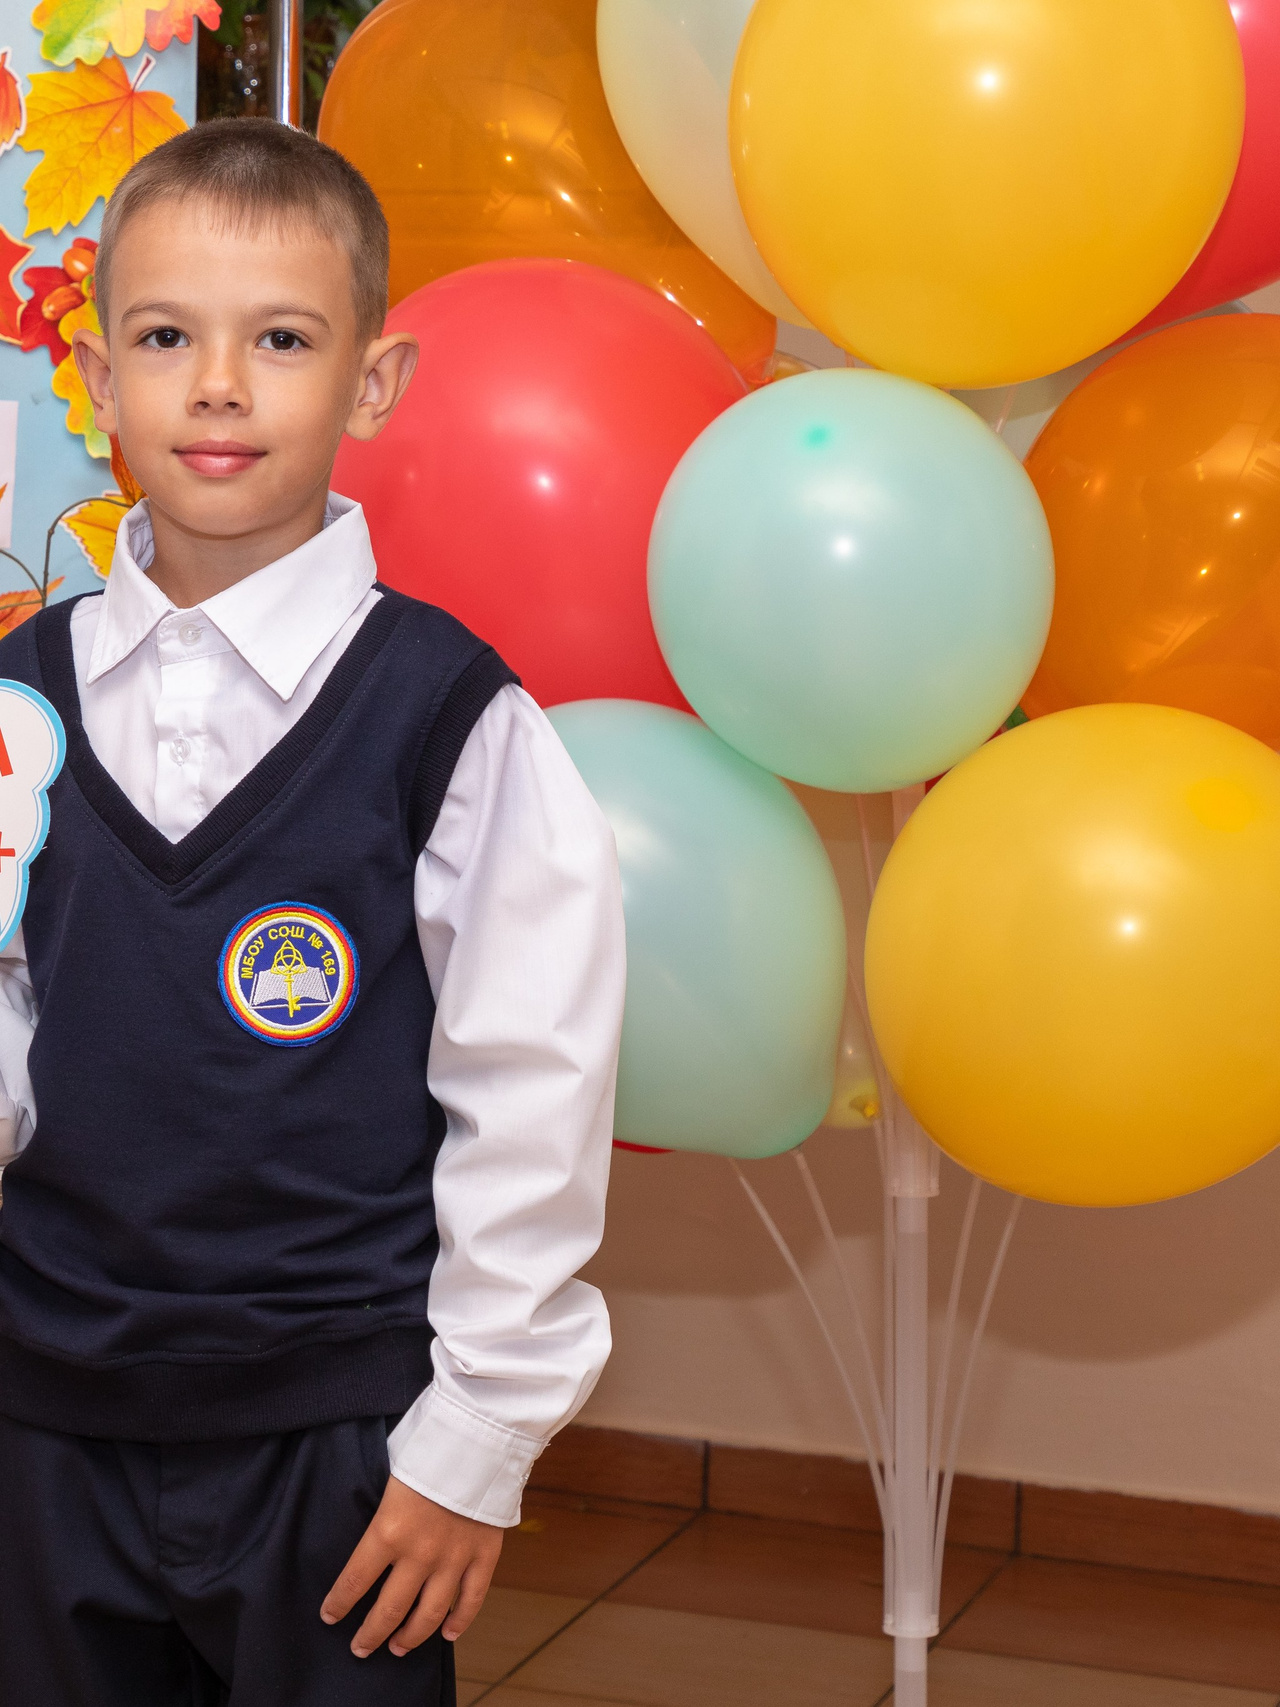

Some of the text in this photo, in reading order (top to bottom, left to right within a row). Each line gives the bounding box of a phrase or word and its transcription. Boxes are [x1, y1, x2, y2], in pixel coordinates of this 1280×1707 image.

[241, 936, 265, 979] МБОУ
[268, 926, 305, 940] СОШ
[321, 950, 336, 976] 169
